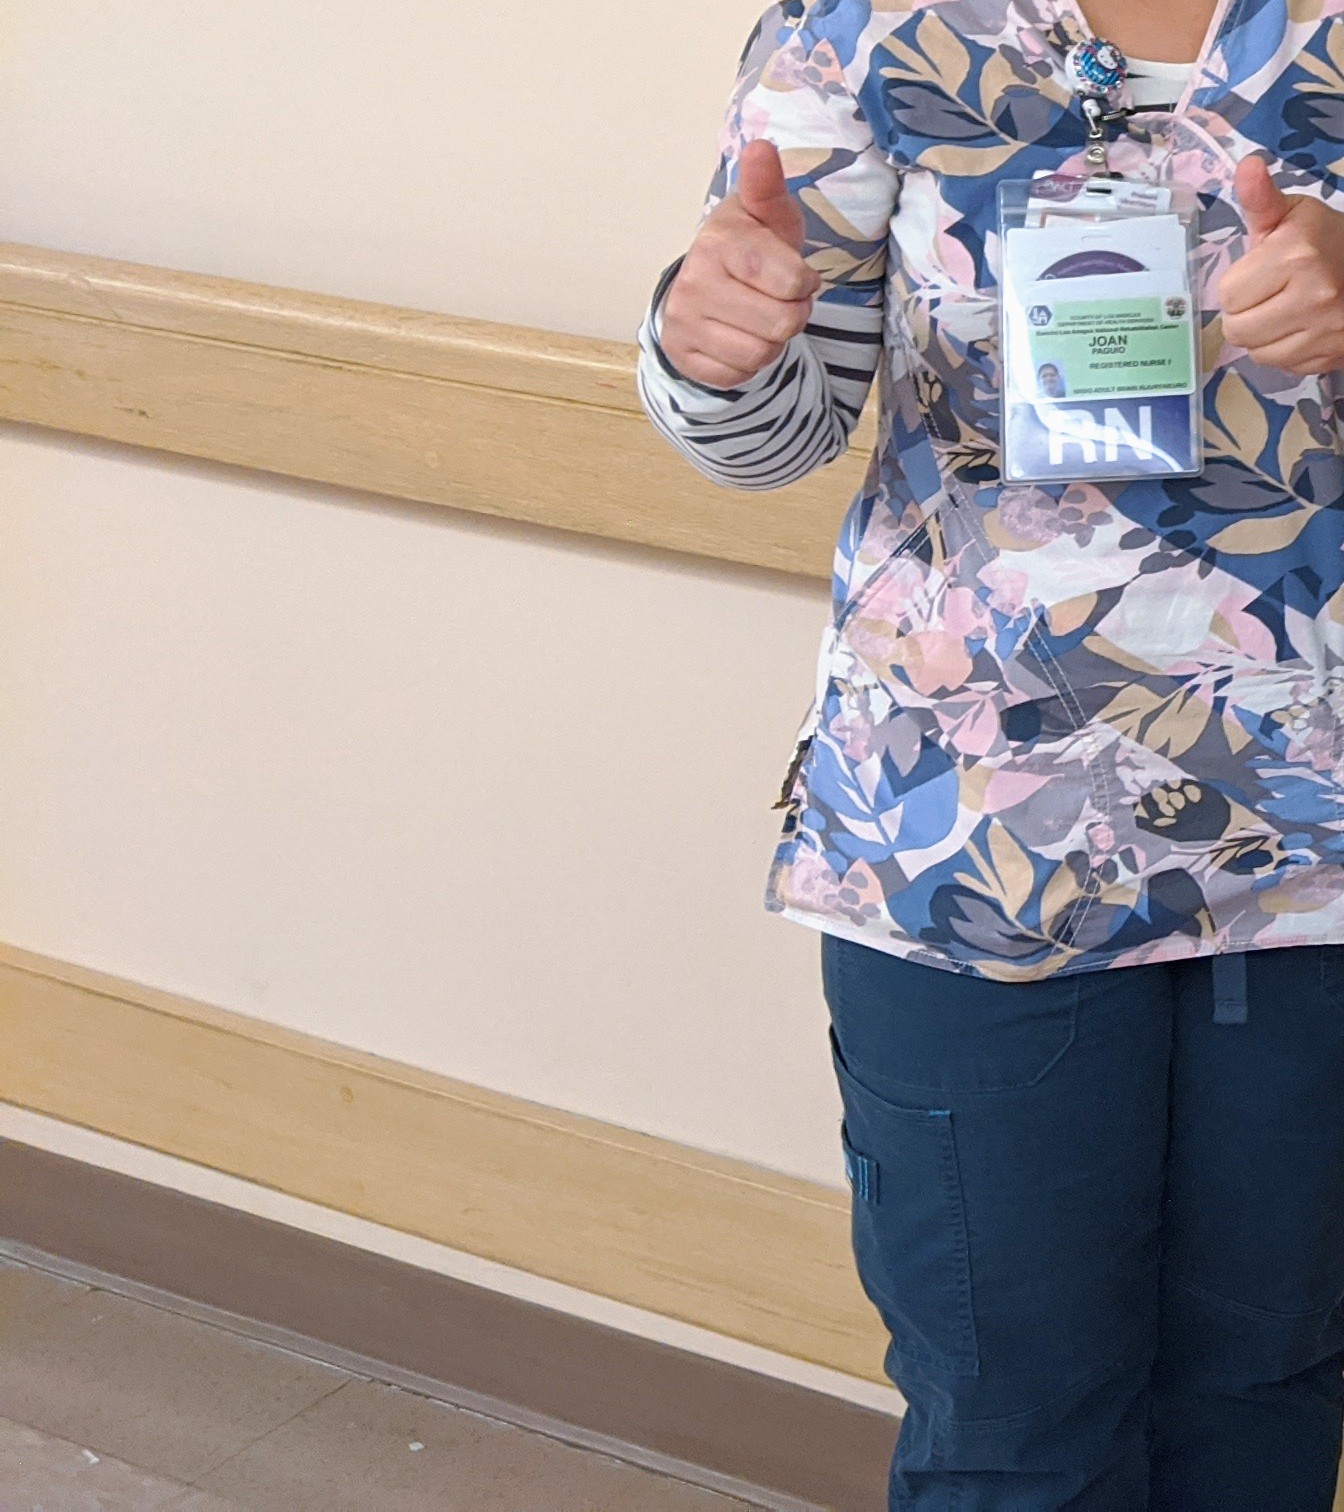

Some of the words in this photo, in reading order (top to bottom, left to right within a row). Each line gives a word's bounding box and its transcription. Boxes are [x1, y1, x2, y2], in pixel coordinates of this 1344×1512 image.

[1089, 335, 1127, 347] JOAN
[1090, 360, 1139, 369] REGISTERED
[1140, 359, 1166, 367] NURSE
[1049, 406, 1153, 465] RN
